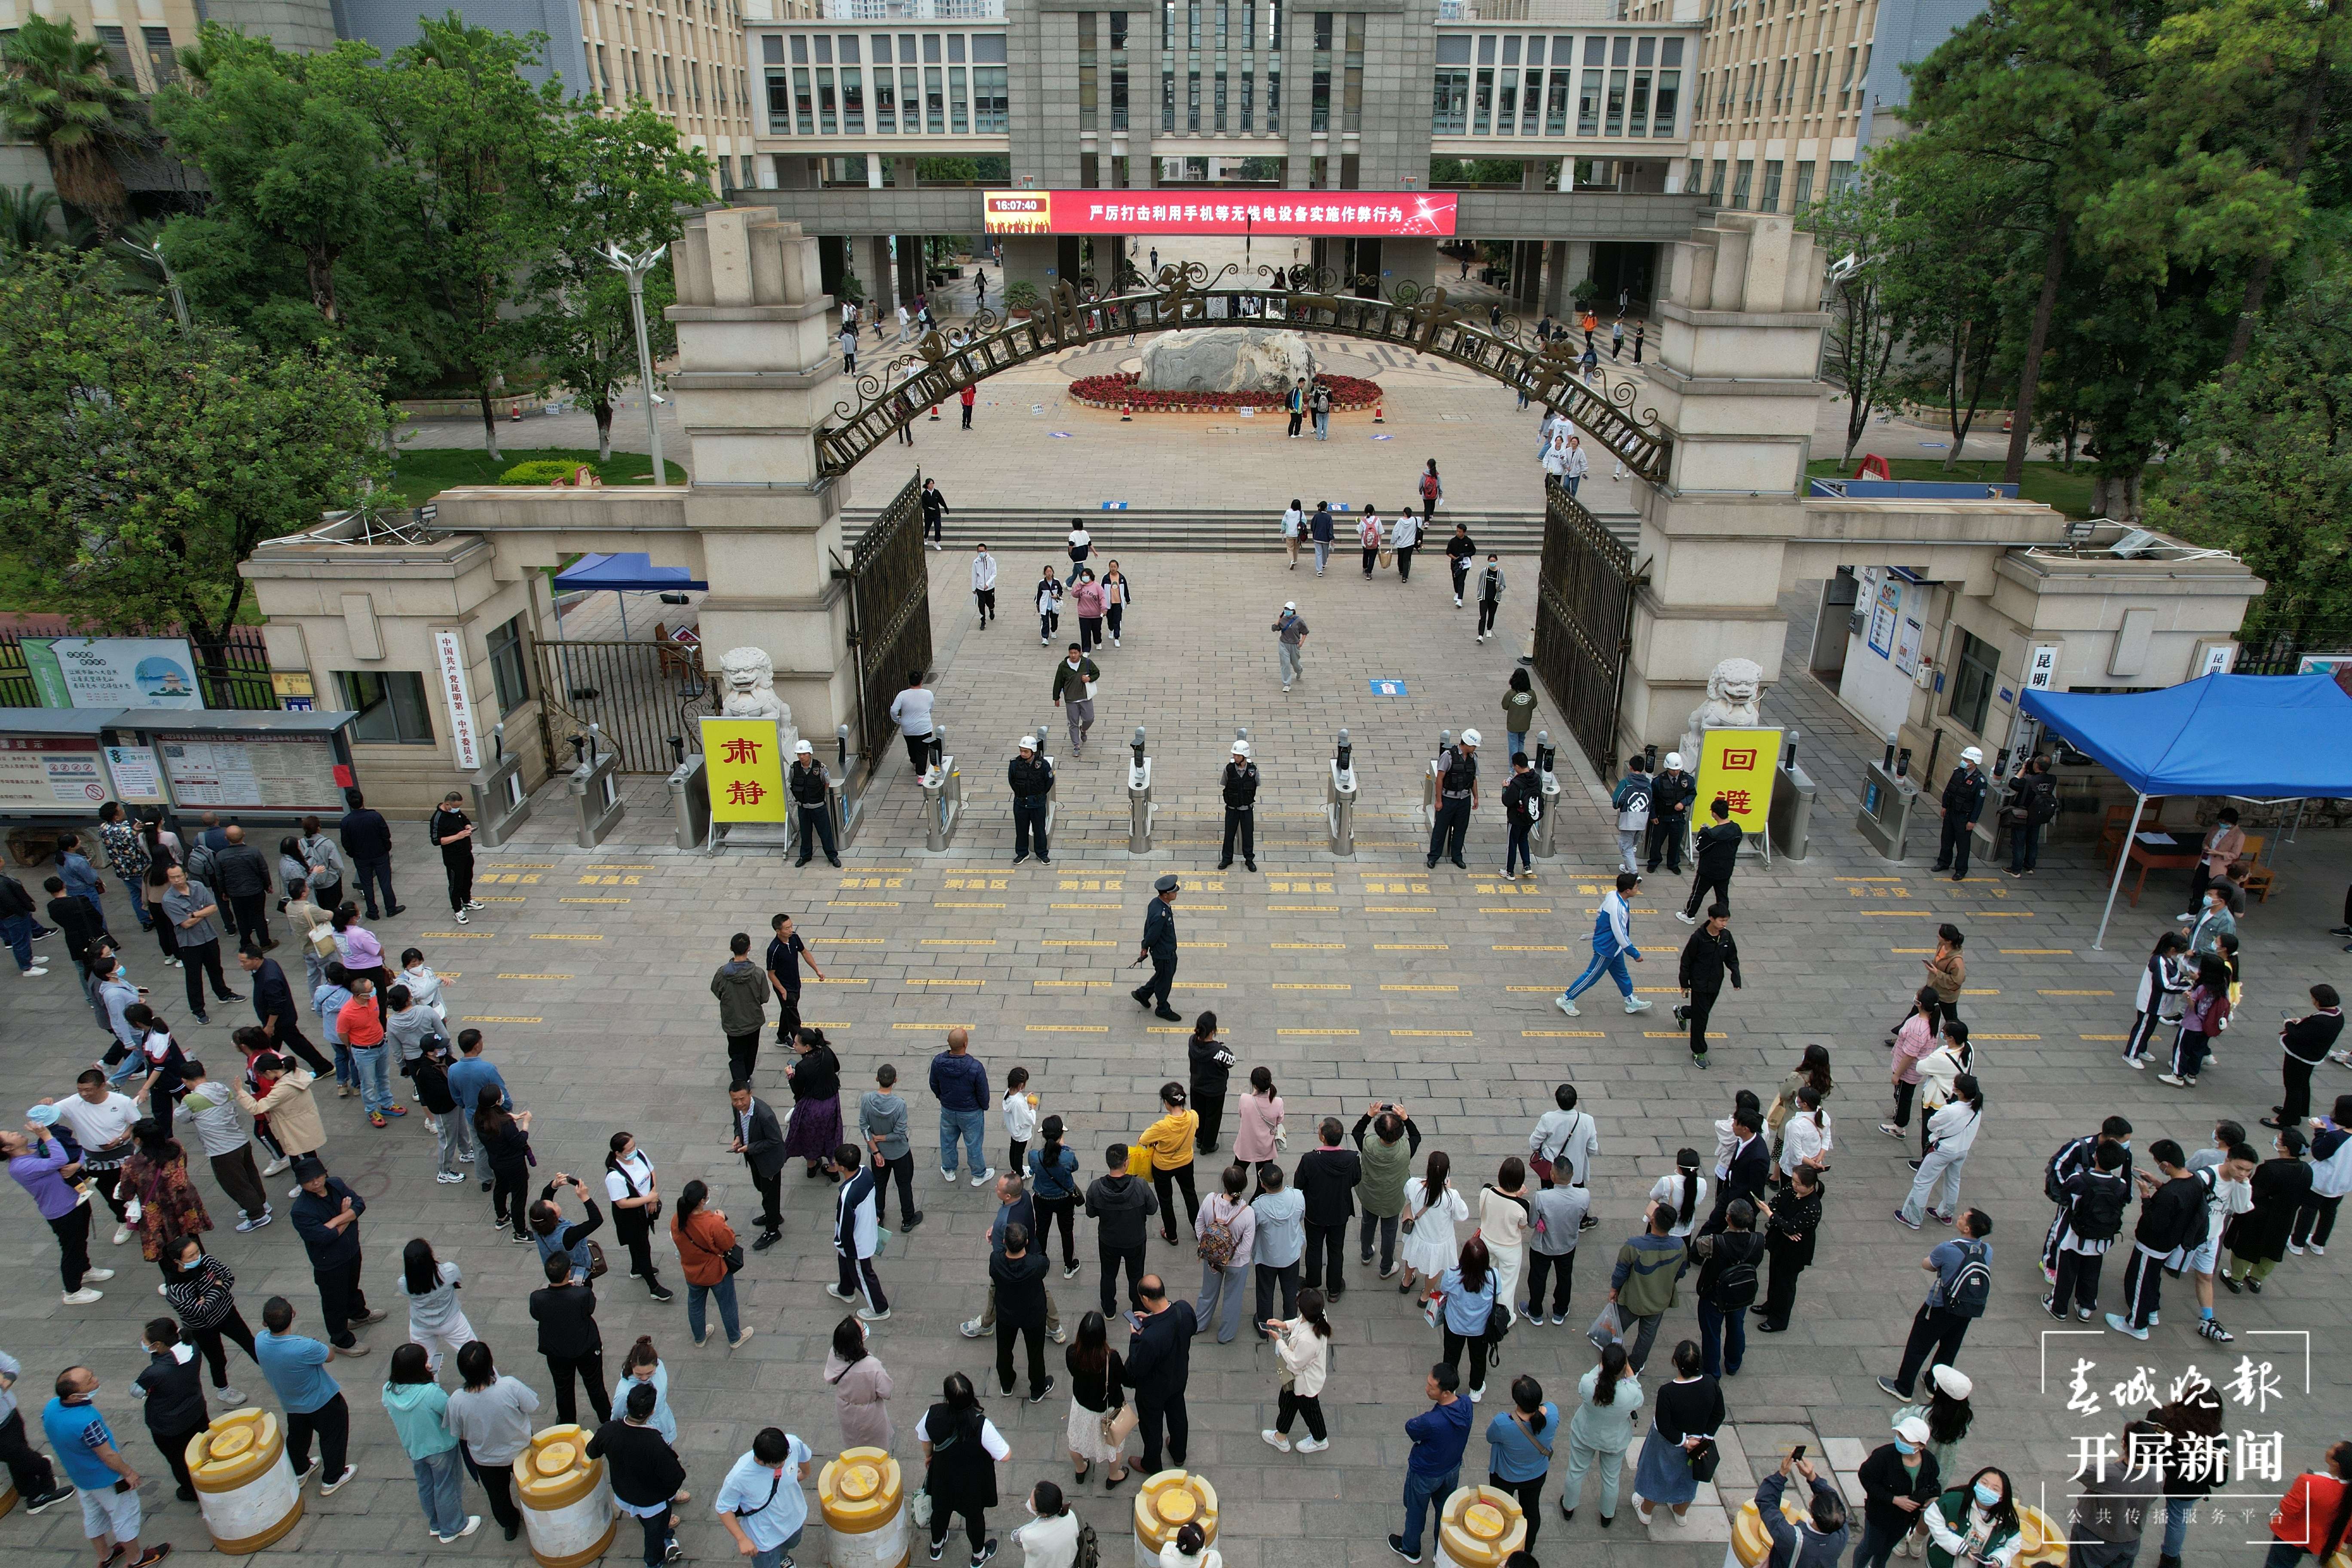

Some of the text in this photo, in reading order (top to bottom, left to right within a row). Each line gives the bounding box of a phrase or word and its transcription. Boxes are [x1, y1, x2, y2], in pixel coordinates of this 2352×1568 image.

[995, 200, 1037, 211] 16:07:40
[1089, 204, 1403, 224] 严厉打击利用手机等无线电设备实施作弊行为
[442, 638, 473, 763] 中国共产党昆明第一中学委员会
[720, 738, 767, 805] 肃静
[1717, 748, 1758, 815] 回避
[476, 873, 542, 883] 测温区
[578, 875, 643, 885] 测温区
[839, 878, 904, 888] 测温区
[944, 879, 1008, 889] 测温区
[1059, 880, 1123, 890] 测温区
[1179, 882, 1225, 891] 温区
[1269, 882, 1334, 892] 测温区
[1366, 883, 1430, 894] 测温区
[1475, 884, 1541, 894] 测温区
